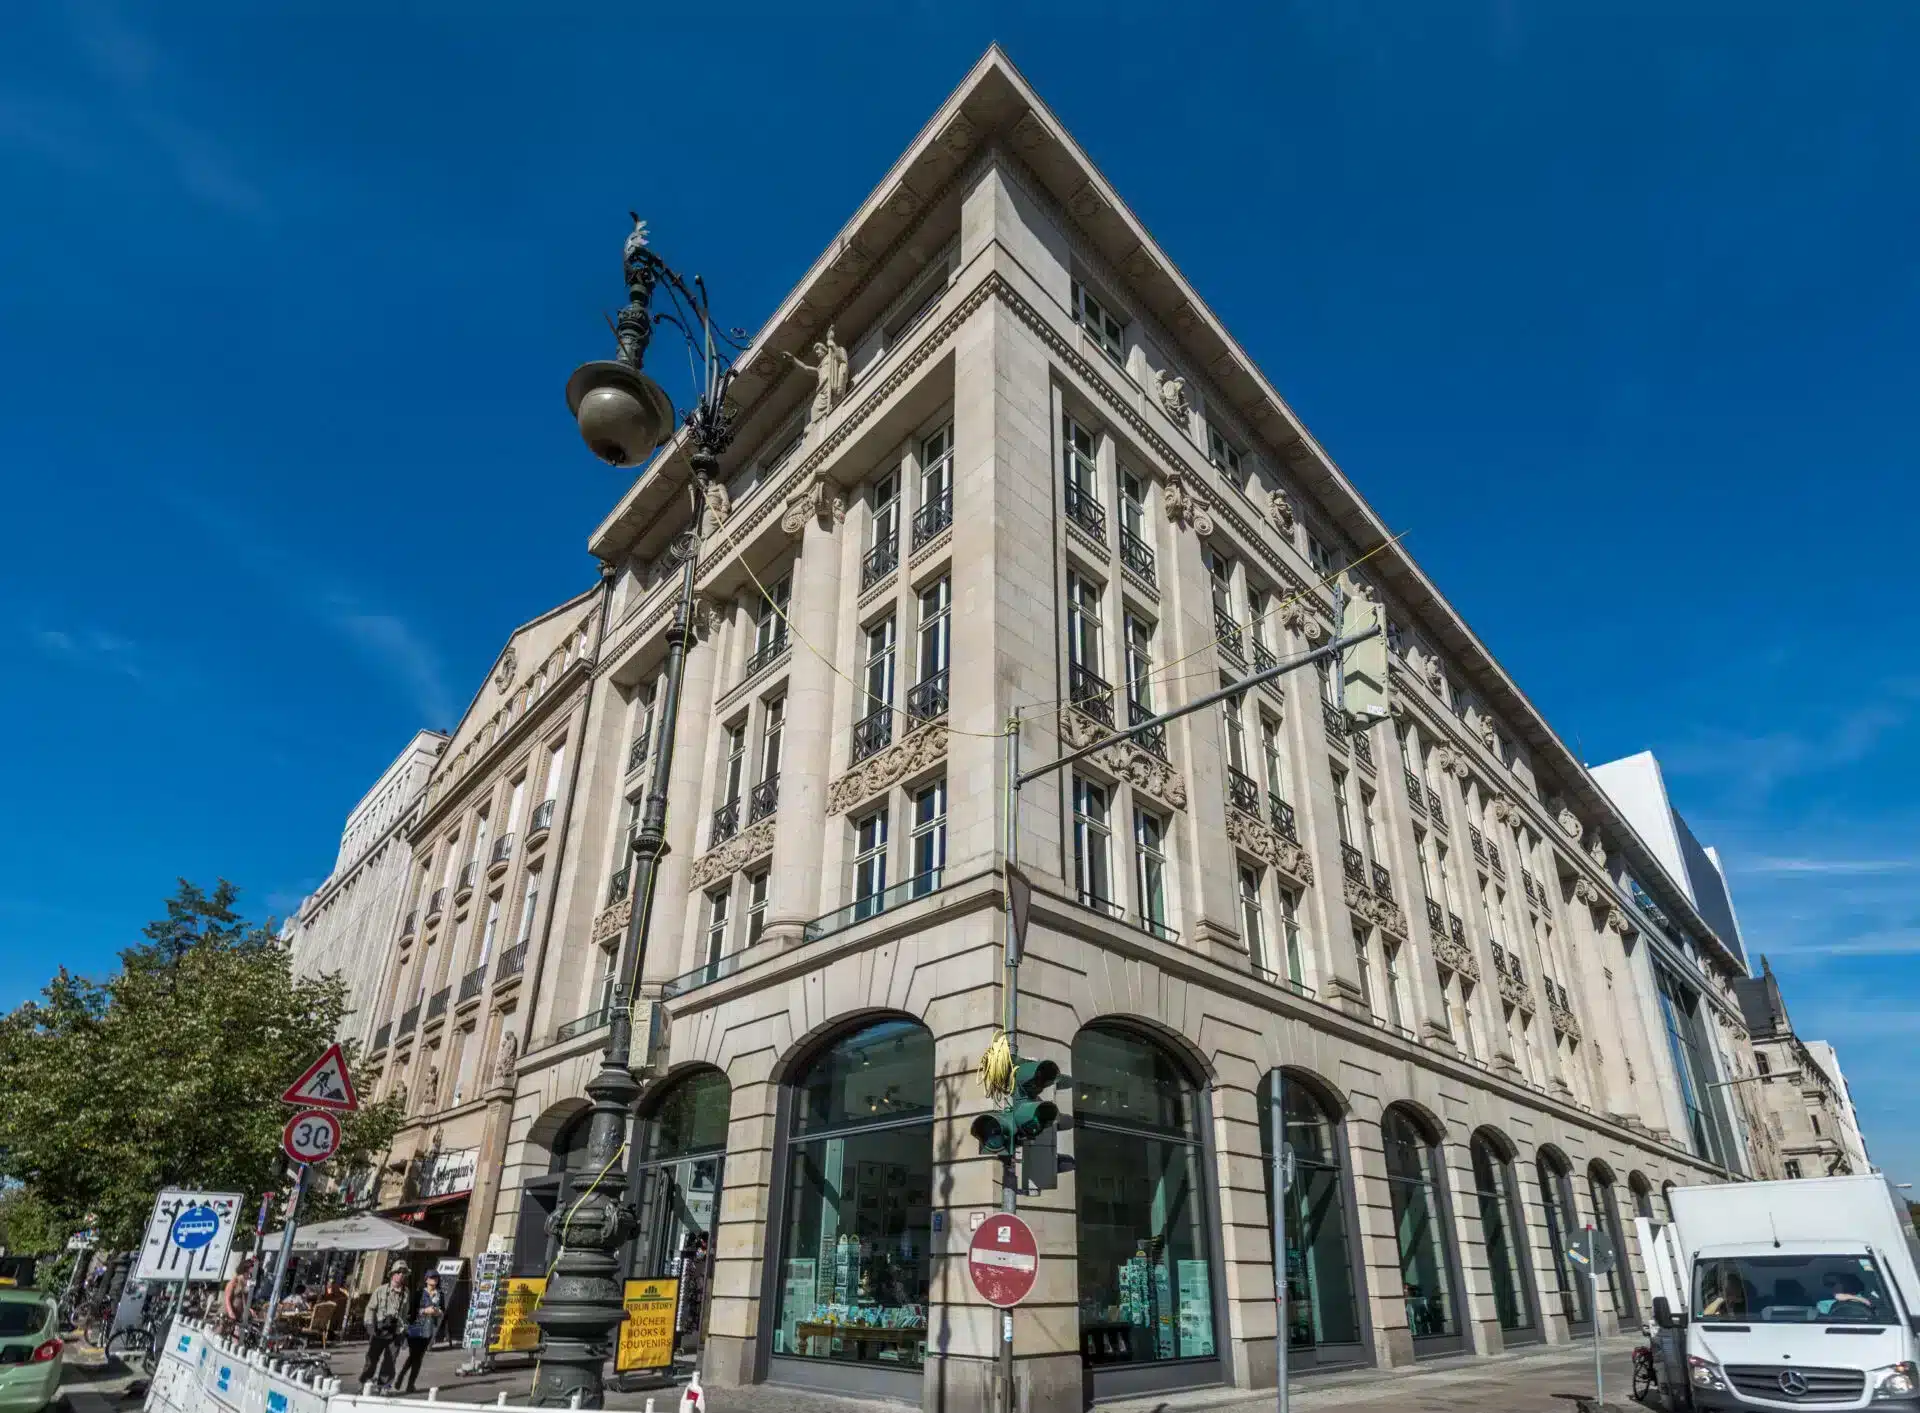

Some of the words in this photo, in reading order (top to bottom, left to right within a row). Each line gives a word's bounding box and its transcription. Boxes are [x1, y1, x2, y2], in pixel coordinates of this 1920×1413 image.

[295, 1123, 330, 1150] 30
[626, 1303, 649, 1312] BERLIN
[651, 1302, 673, 1310] STORY
[631, 1315, 666, 1327] BÜCHER
[627, 1328, 659, 1339] BOOKS
[660, 1327, 667, 1336] &
[620, 1338, 672, 1350] SOUVENIRS
